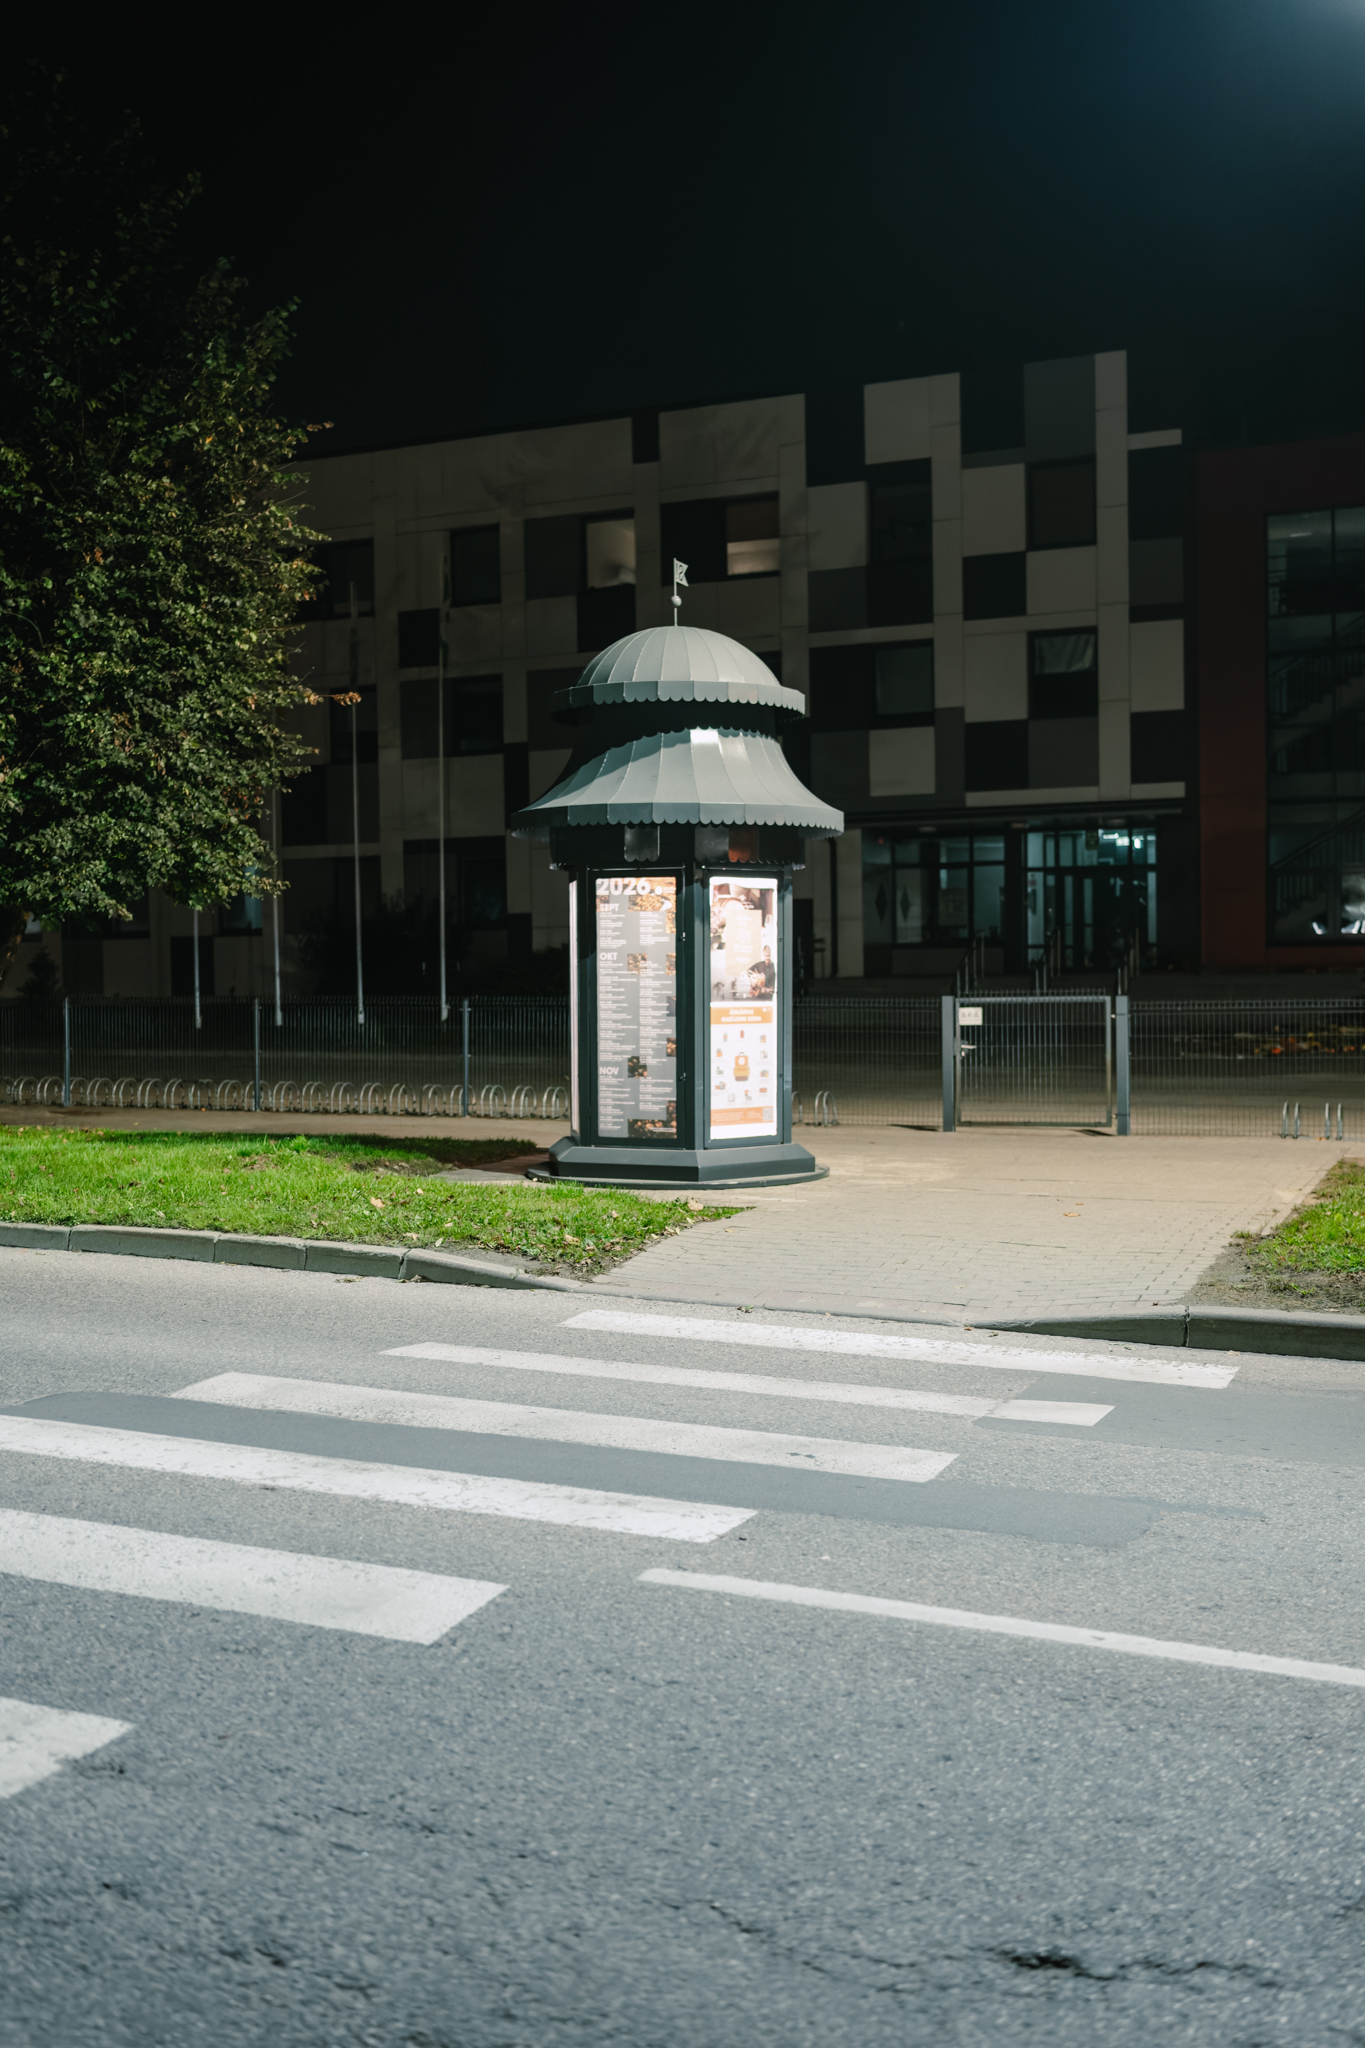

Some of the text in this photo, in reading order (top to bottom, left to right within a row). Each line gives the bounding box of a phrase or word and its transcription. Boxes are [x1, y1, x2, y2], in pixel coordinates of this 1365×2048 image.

[600, 903, 619, 912] SEPT
[600, 952, 618, 961] OKT
[600, 1066, 619, 1075] NOV
